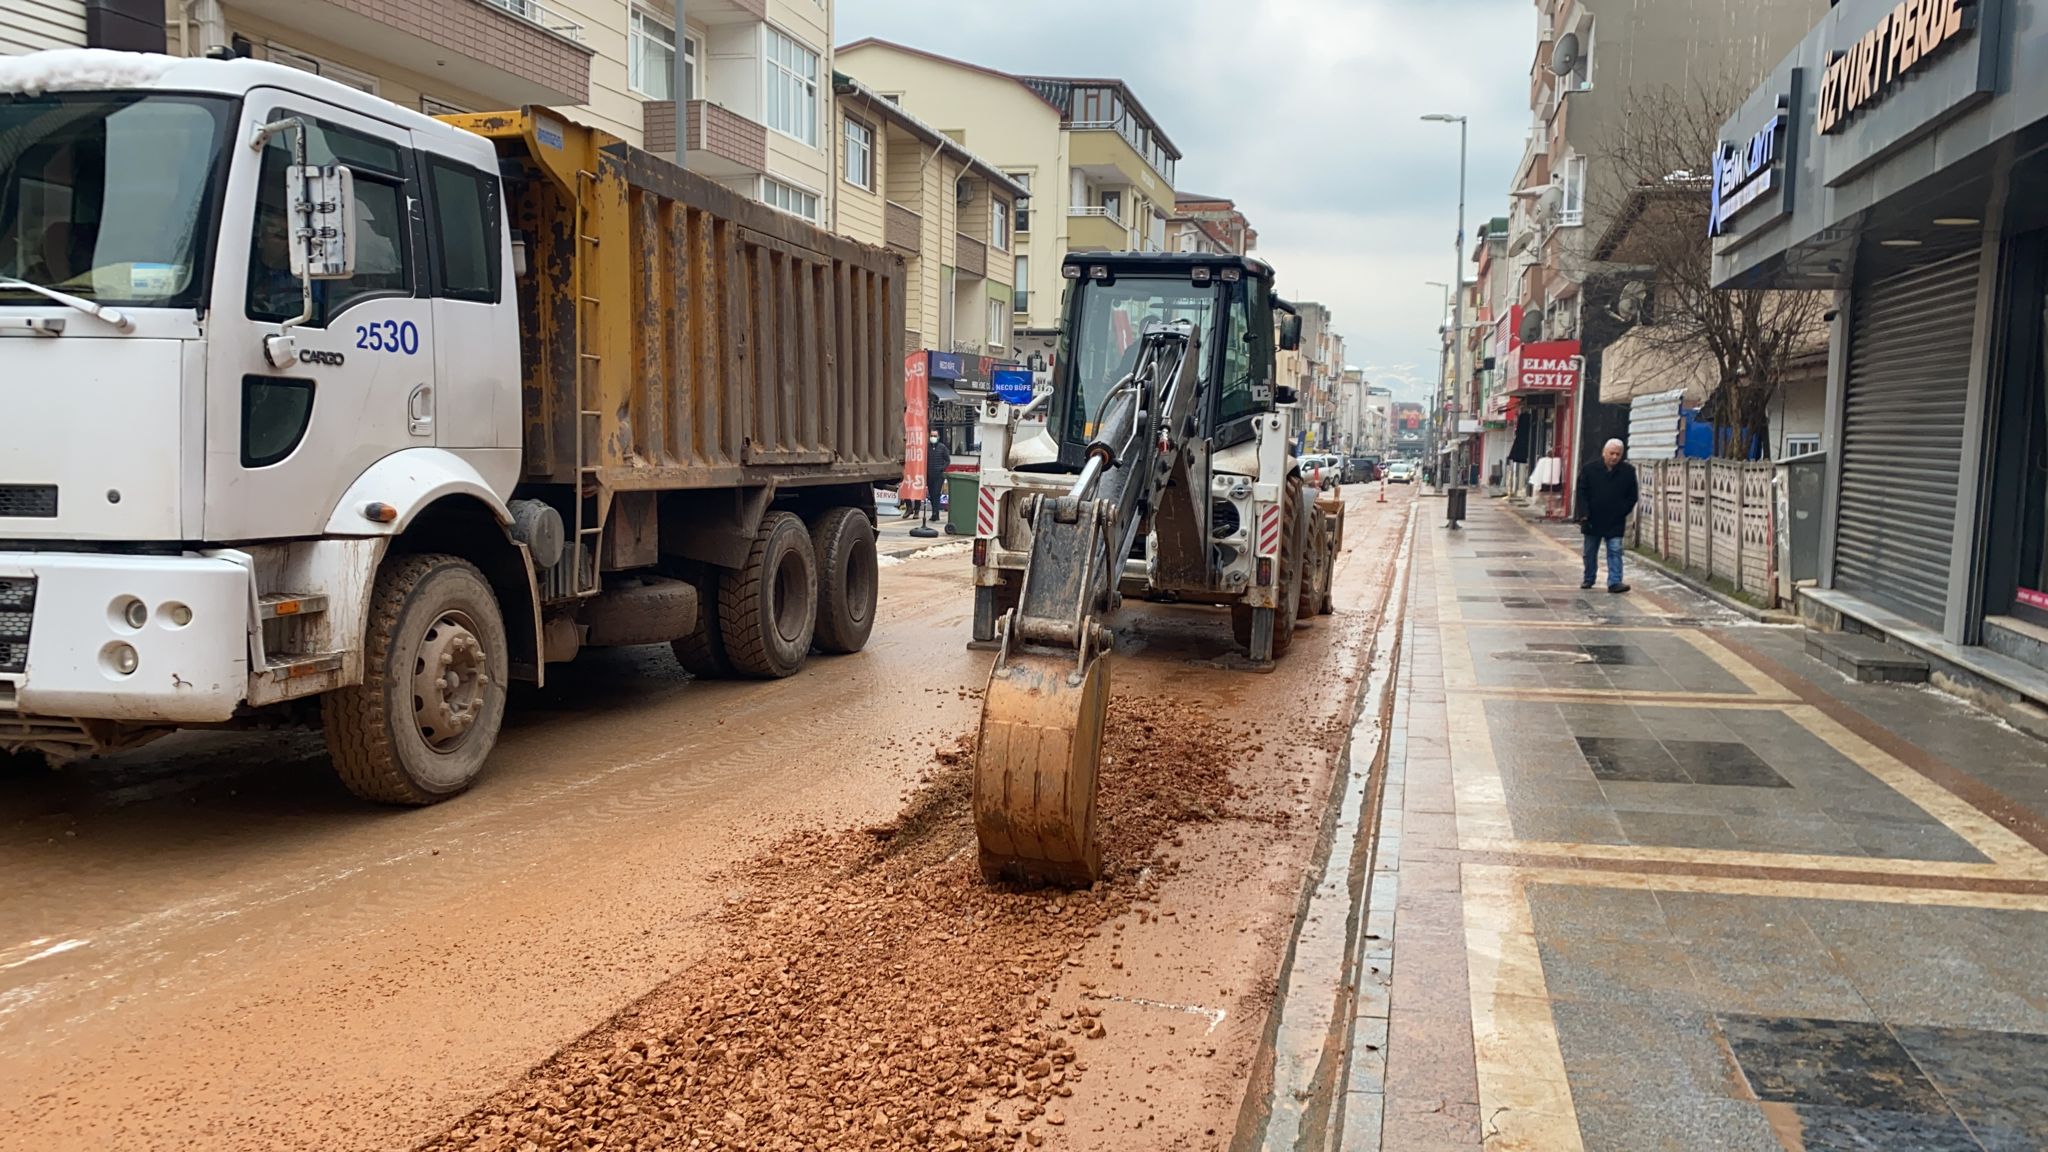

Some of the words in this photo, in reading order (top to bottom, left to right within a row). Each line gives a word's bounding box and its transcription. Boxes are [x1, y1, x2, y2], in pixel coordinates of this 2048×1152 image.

[1817, 13, 1892, 136] ÖZYURT
[356, 319, 419, 355] 2530
[299, 349, 345, 366] CARGO
[1522, 358, 1579, 371] ELMAS
[1014, 382, 1032, 391] BÜFE
[1522, 372, 1573, 387] ÇEYİZ
